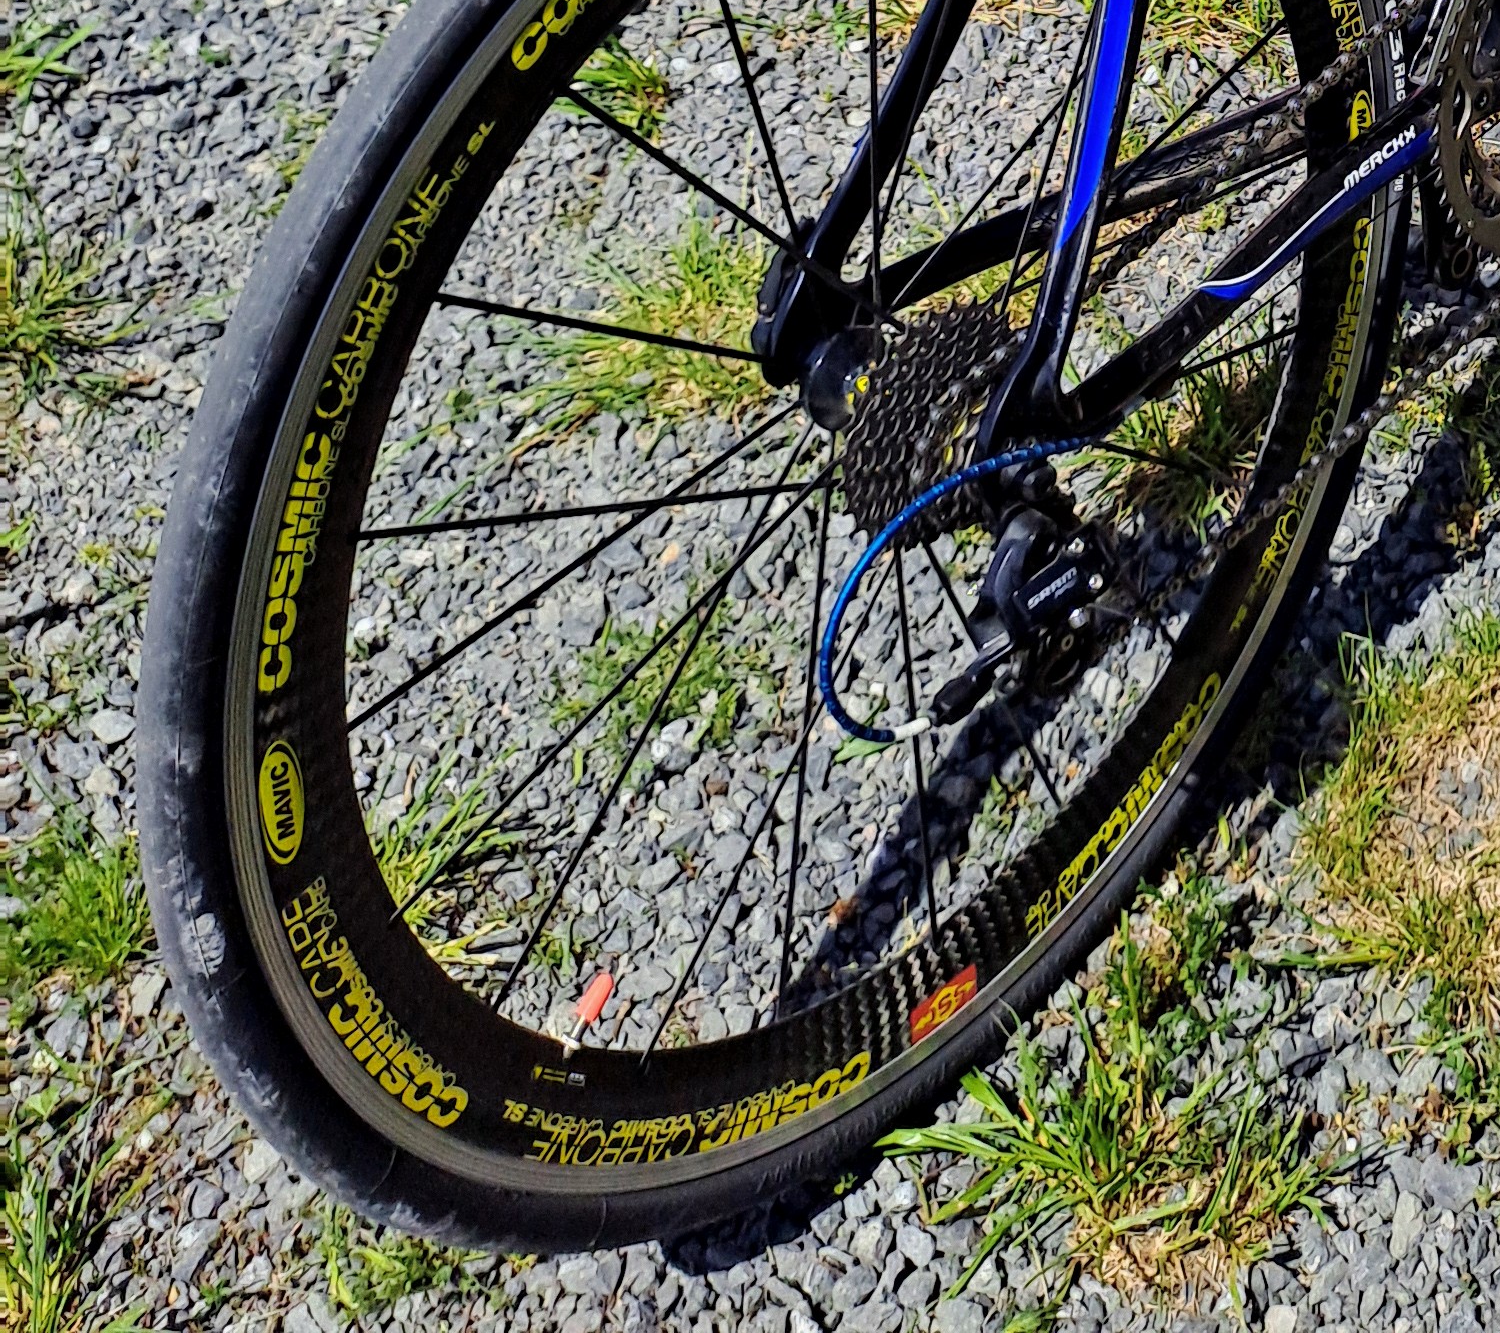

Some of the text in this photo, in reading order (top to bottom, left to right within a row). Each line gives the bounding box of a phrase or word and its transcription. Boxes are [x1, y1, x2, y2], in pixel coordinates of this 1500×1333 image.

[1343, 123, 1418, 192] MERCKX
[257, 164, 439, 694] COSMIC CARBONE
[269, 760, 296, 841] MAVIC
[327, 987, 469, 1129] COSMIC
